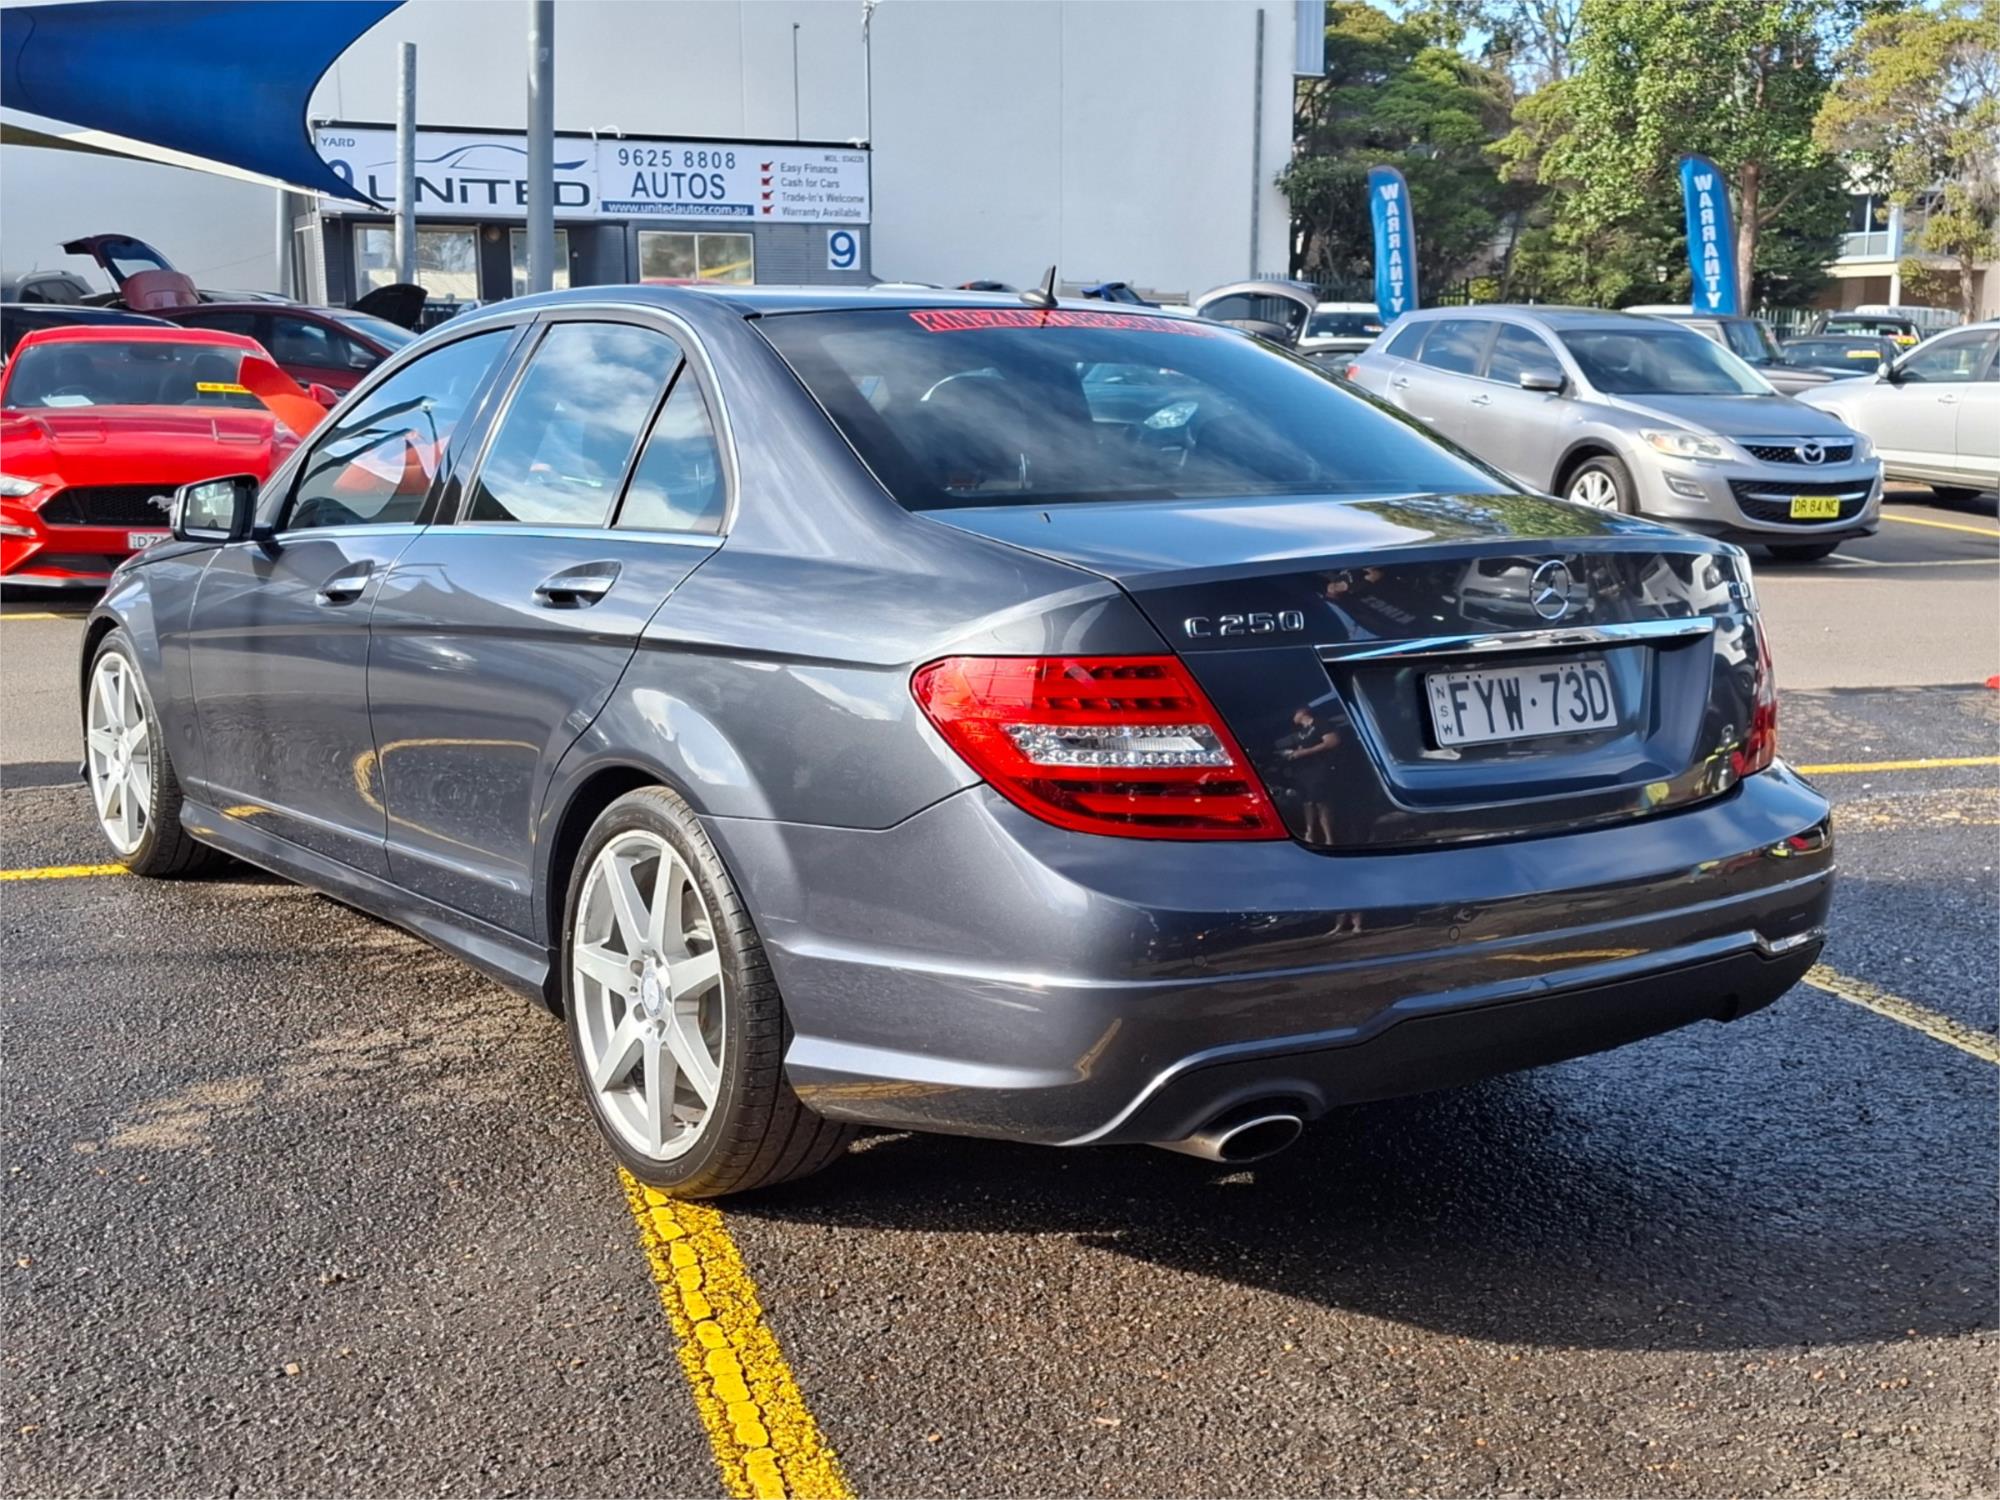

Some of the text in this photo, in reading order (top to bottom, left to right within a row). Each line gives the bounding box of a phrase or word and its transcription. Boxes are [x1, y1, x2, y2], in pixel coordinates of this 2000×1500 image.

[321, 137, 356, 147] YARD
[618, 148, 736, 169] 9625 8808
[780, 162, 838, 175] Easy Finance
[631, 171, 726, 200] AUTOS
[781, 177, 840, 189] Cash for Cars
[826, 193, 865, 204] Welcome
[607, 202, 749, 216] www.unitedautos.com.au
[781, 206, 862, 219] Warranty Available
[829, 231, 856, 268] 9
[1794, 499, 1808, 513] DR
[1184, 610, 1304, 638] C 250
